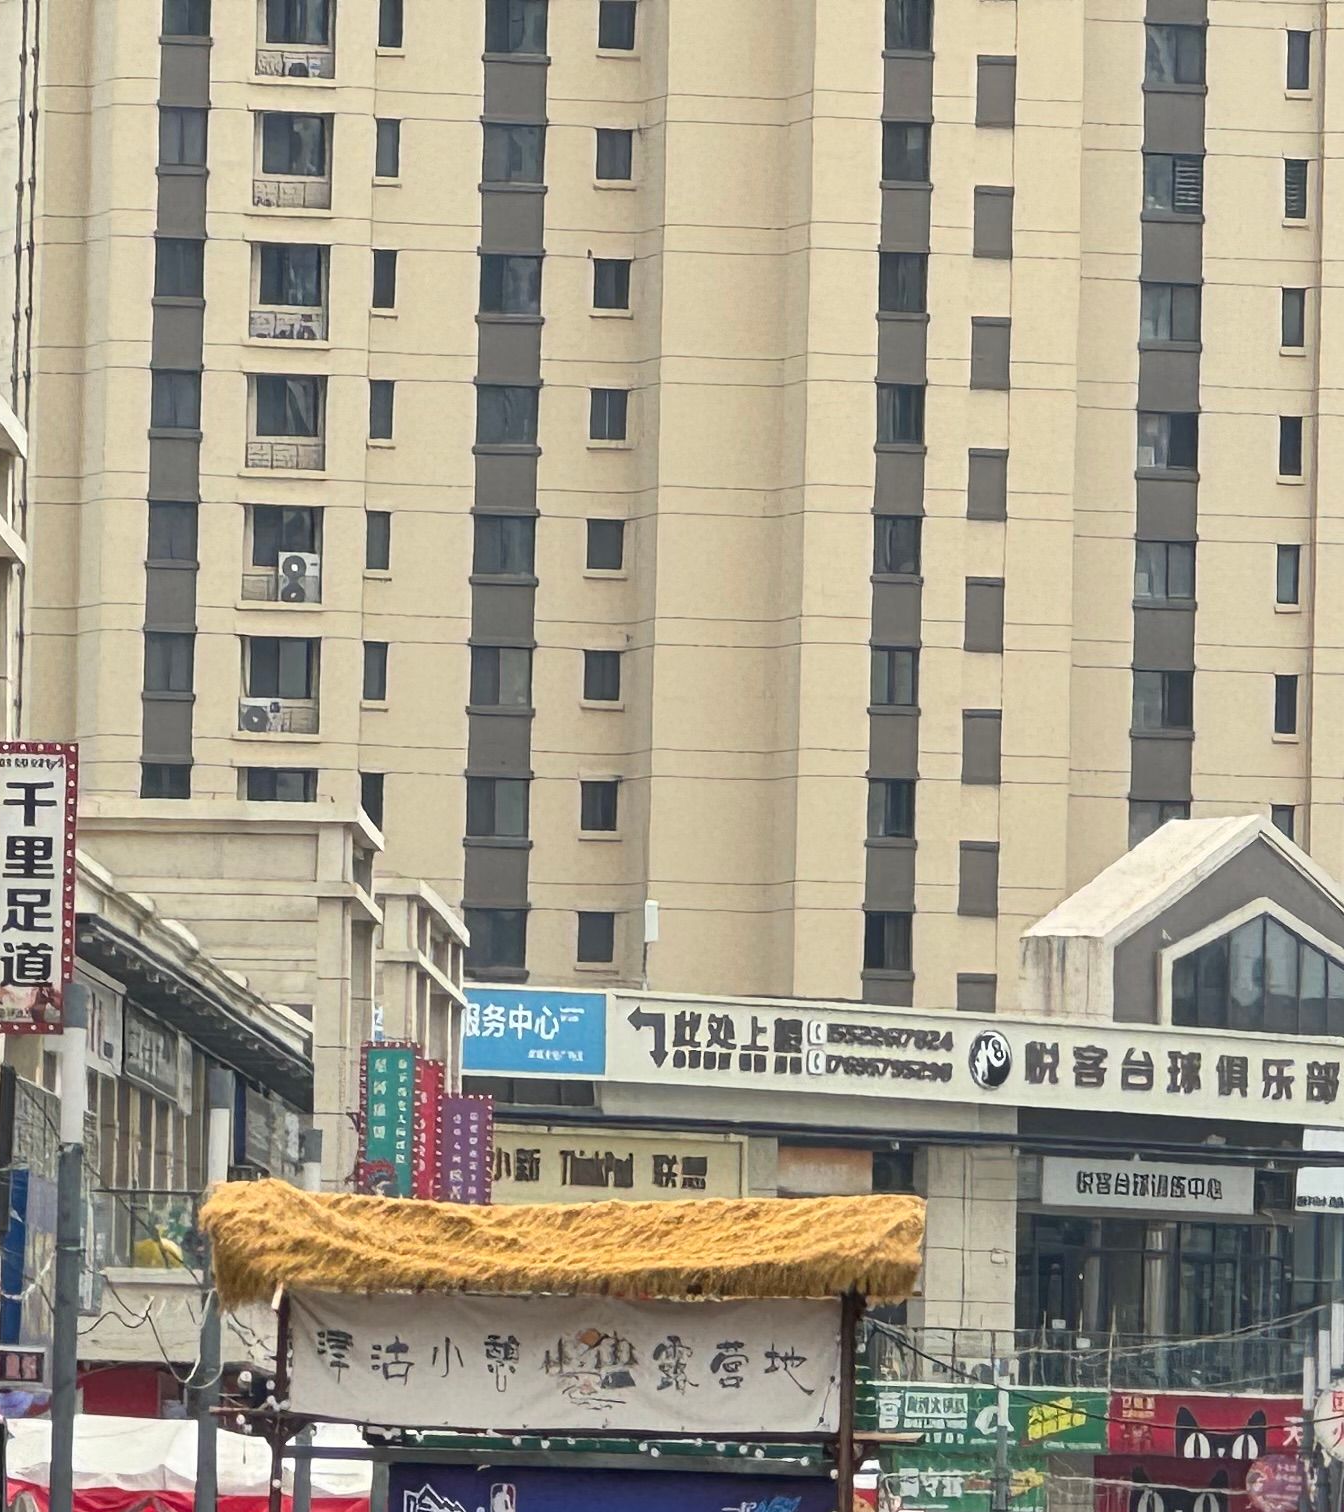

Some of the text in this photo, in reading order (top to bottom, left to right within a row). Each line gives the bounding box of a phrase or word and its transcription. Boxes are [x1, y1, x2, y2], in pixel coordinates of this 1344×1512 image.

[0, 777, 58, 988] 千里足道
[1024, 1040, 1341, 1104] 悦客台球俱乐部
